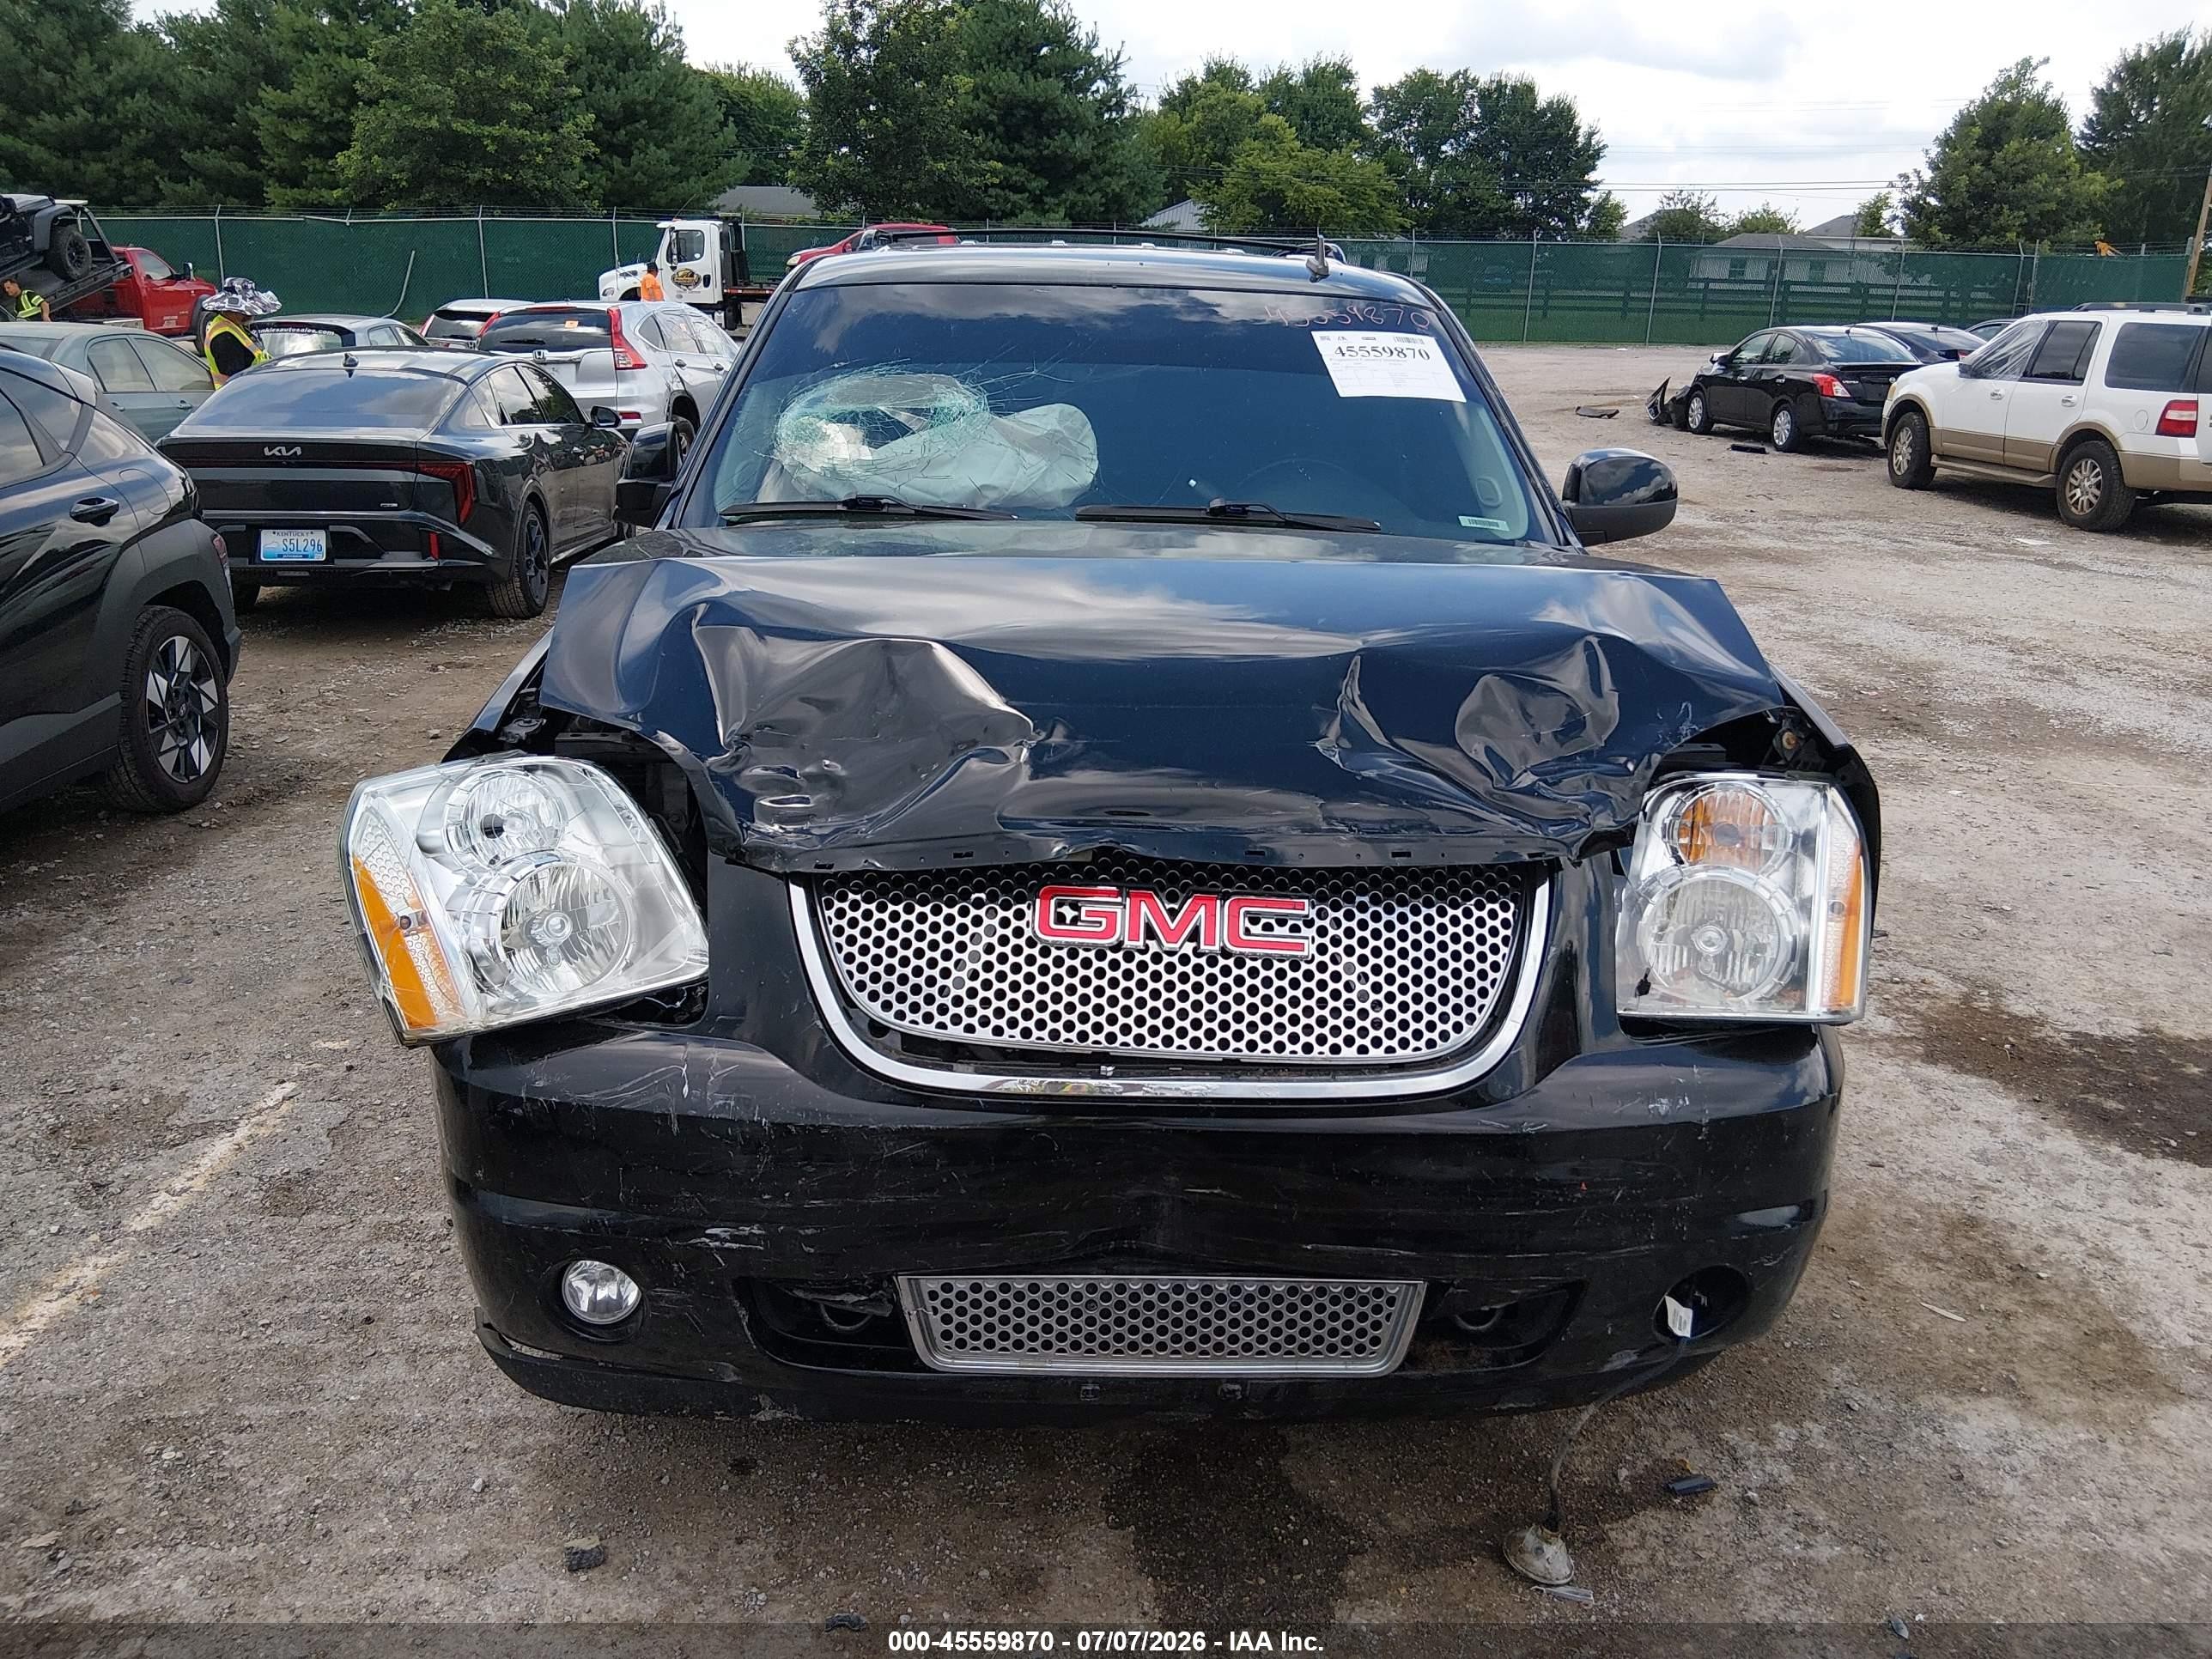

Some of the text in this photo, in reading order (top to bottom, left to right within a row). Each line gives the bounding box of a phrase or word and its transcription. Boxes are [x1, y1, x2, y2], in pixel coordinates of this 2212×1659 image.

[1334, 345, 1431, 361] 45559870
[264, 446, 301, 456] KIA
[282, 538, 323, 552] S5L296
[1034, 884, 1311, 959] GMC
